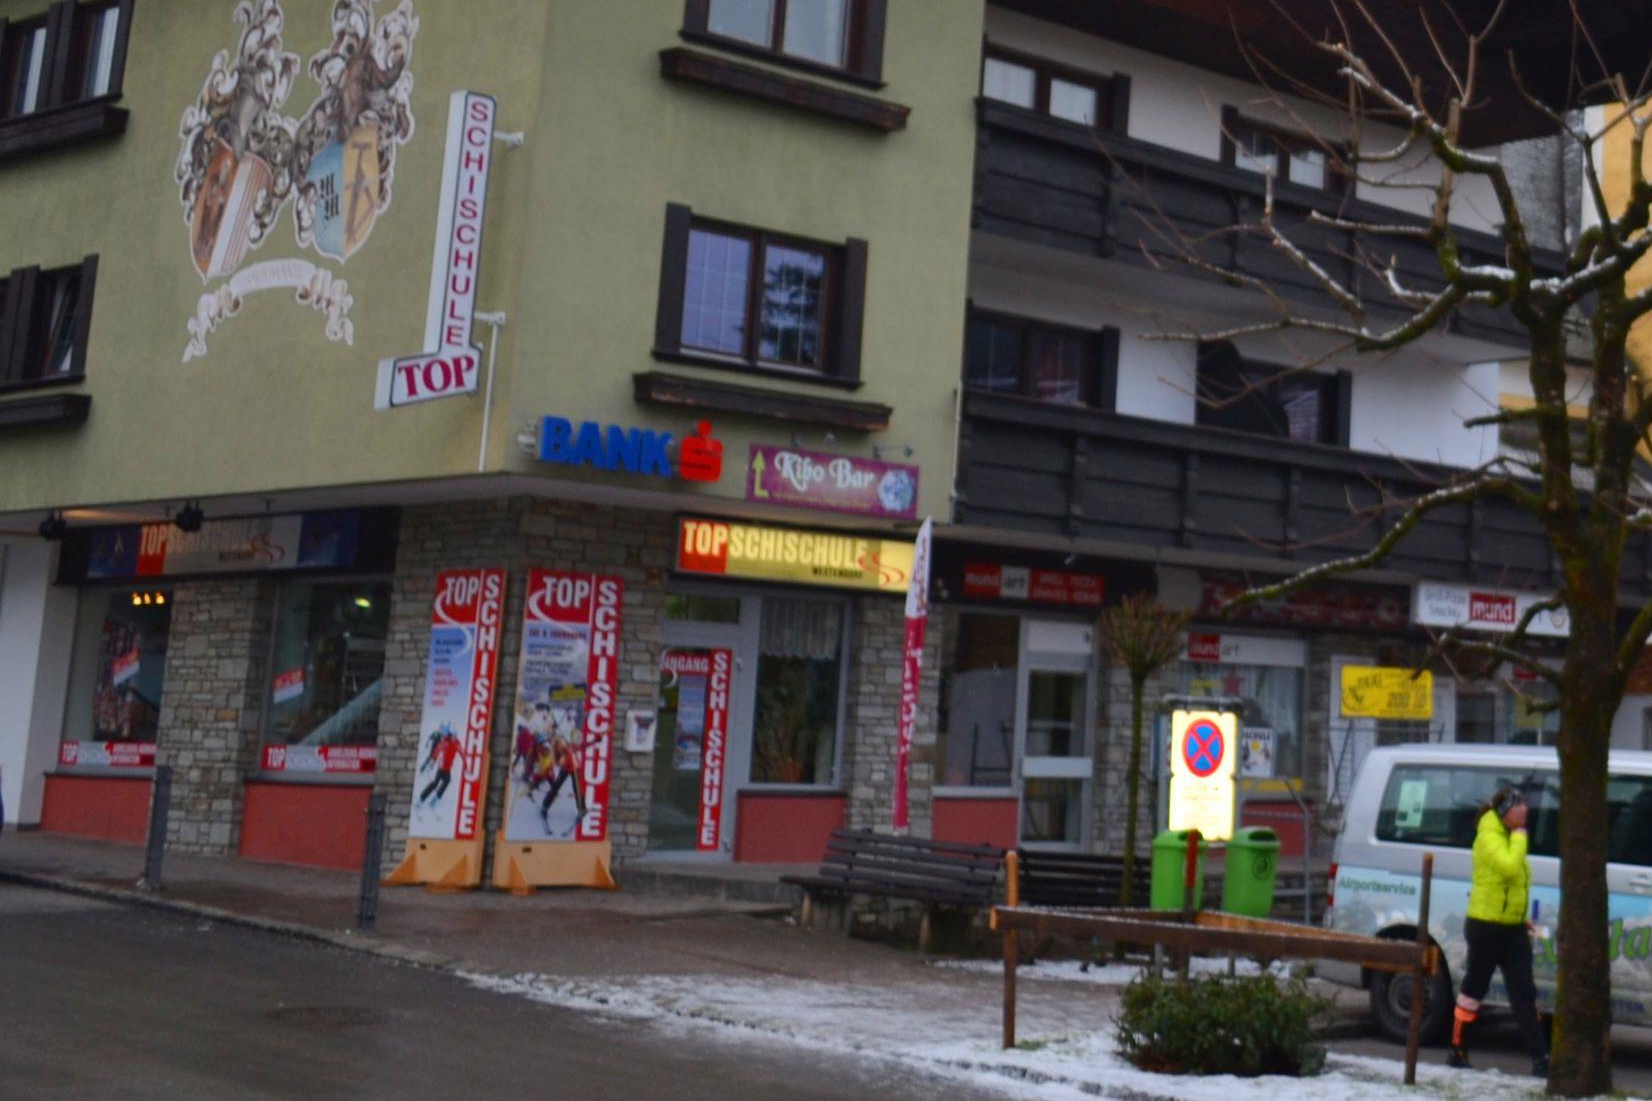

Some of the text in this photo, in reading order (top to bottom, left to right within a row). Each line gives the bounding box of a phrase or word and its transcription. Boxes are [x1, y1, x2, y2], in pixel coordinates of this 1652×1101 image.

[446, 102, 488, 347] SCHISCHULE
[398, 355, 475, 397] TOP
[540, 415, 674, 478] BANK
[830, 458, 876, 488] Bar
[141, 524, 166, 555] TOP
[683, 520, 867, 568] TOP SCHISCHULE
[445, 576, 480, 607] TOP
[544, 576, 590, 609] TOP
[1003, 572, 1027, 590] art
[1472, 600, 1514, 622] mund
[458, 574, 500, 835] SCHISCHULE
[581, 580, 619, 837] SCHISCHULE
[267, 746, 286, 767] TOP
[701, 653, 728, 846] SCHISCHULE
[1339, 875, 1416, 896] Airportservice
